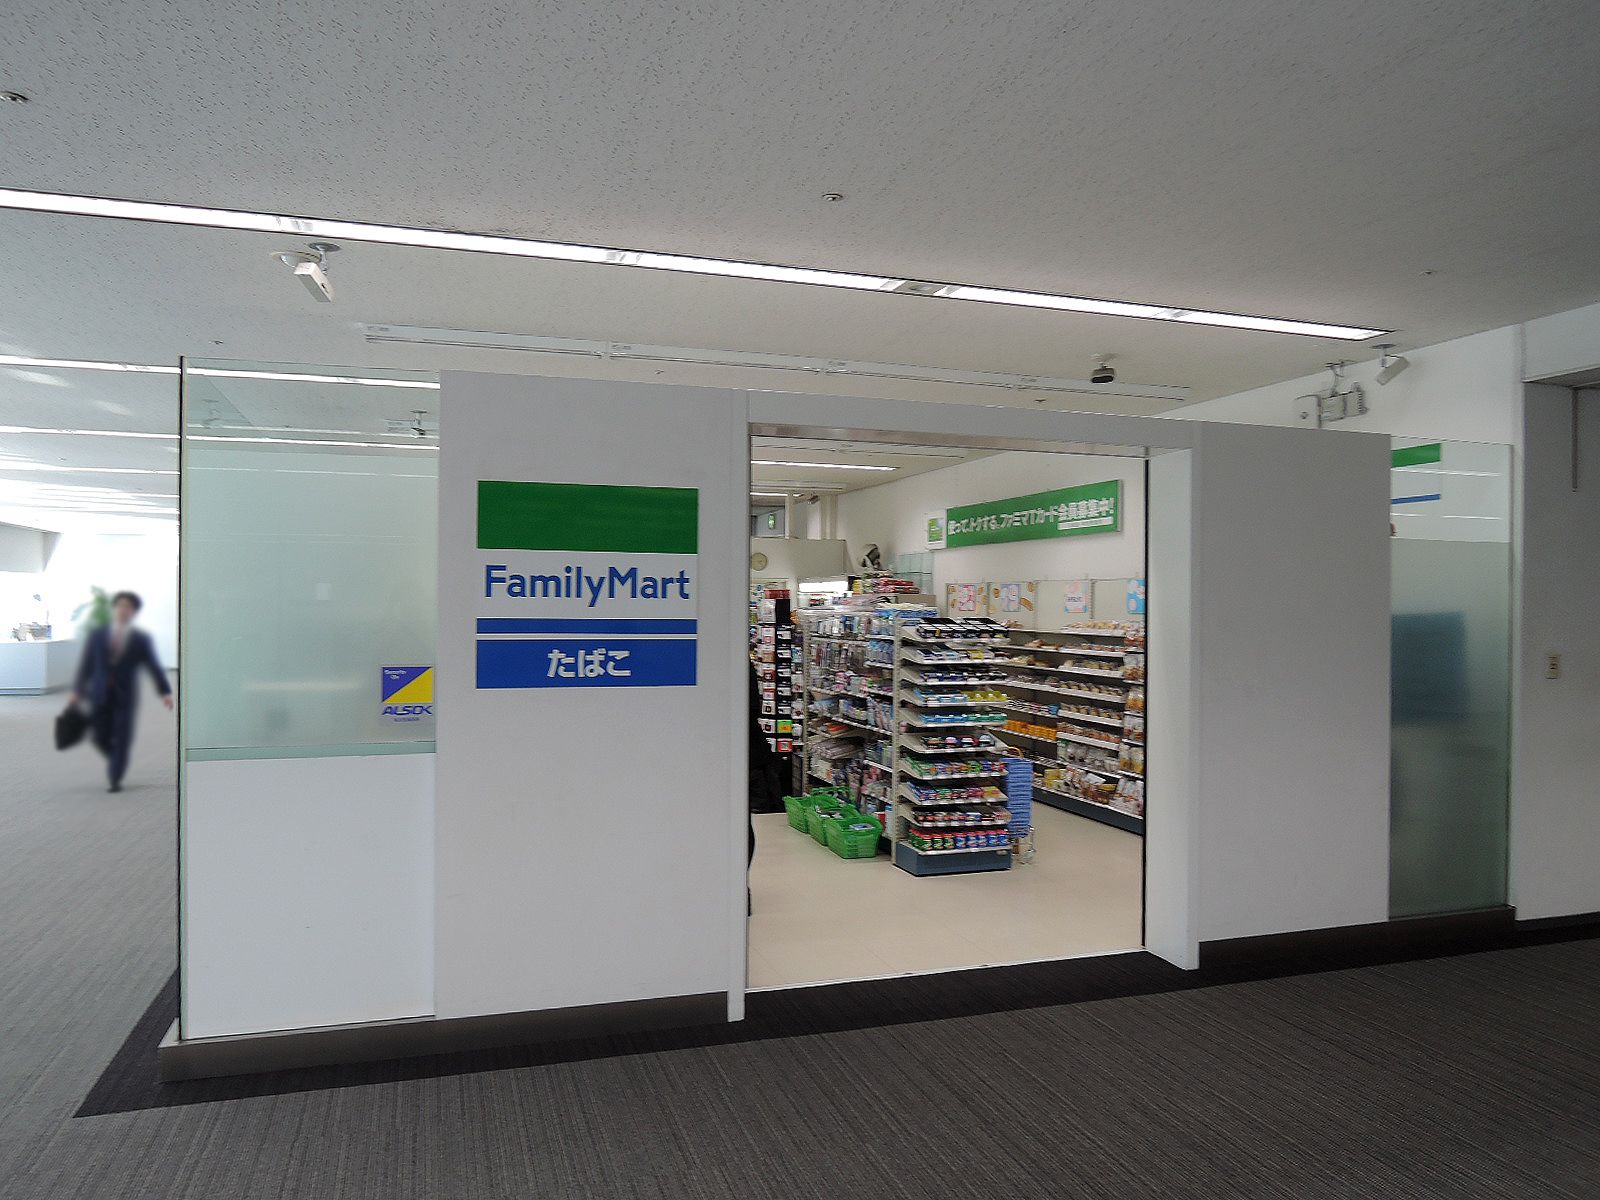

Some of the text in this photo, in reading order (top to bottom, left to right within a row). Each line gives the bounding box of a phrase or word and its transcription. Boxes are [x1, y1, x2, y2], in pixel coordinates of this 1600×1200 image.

[485, 565, 690, 607] FamilyMart
[547, 648, 631, 678] たばこ
[382, 705, 432, 715] ALSOK
